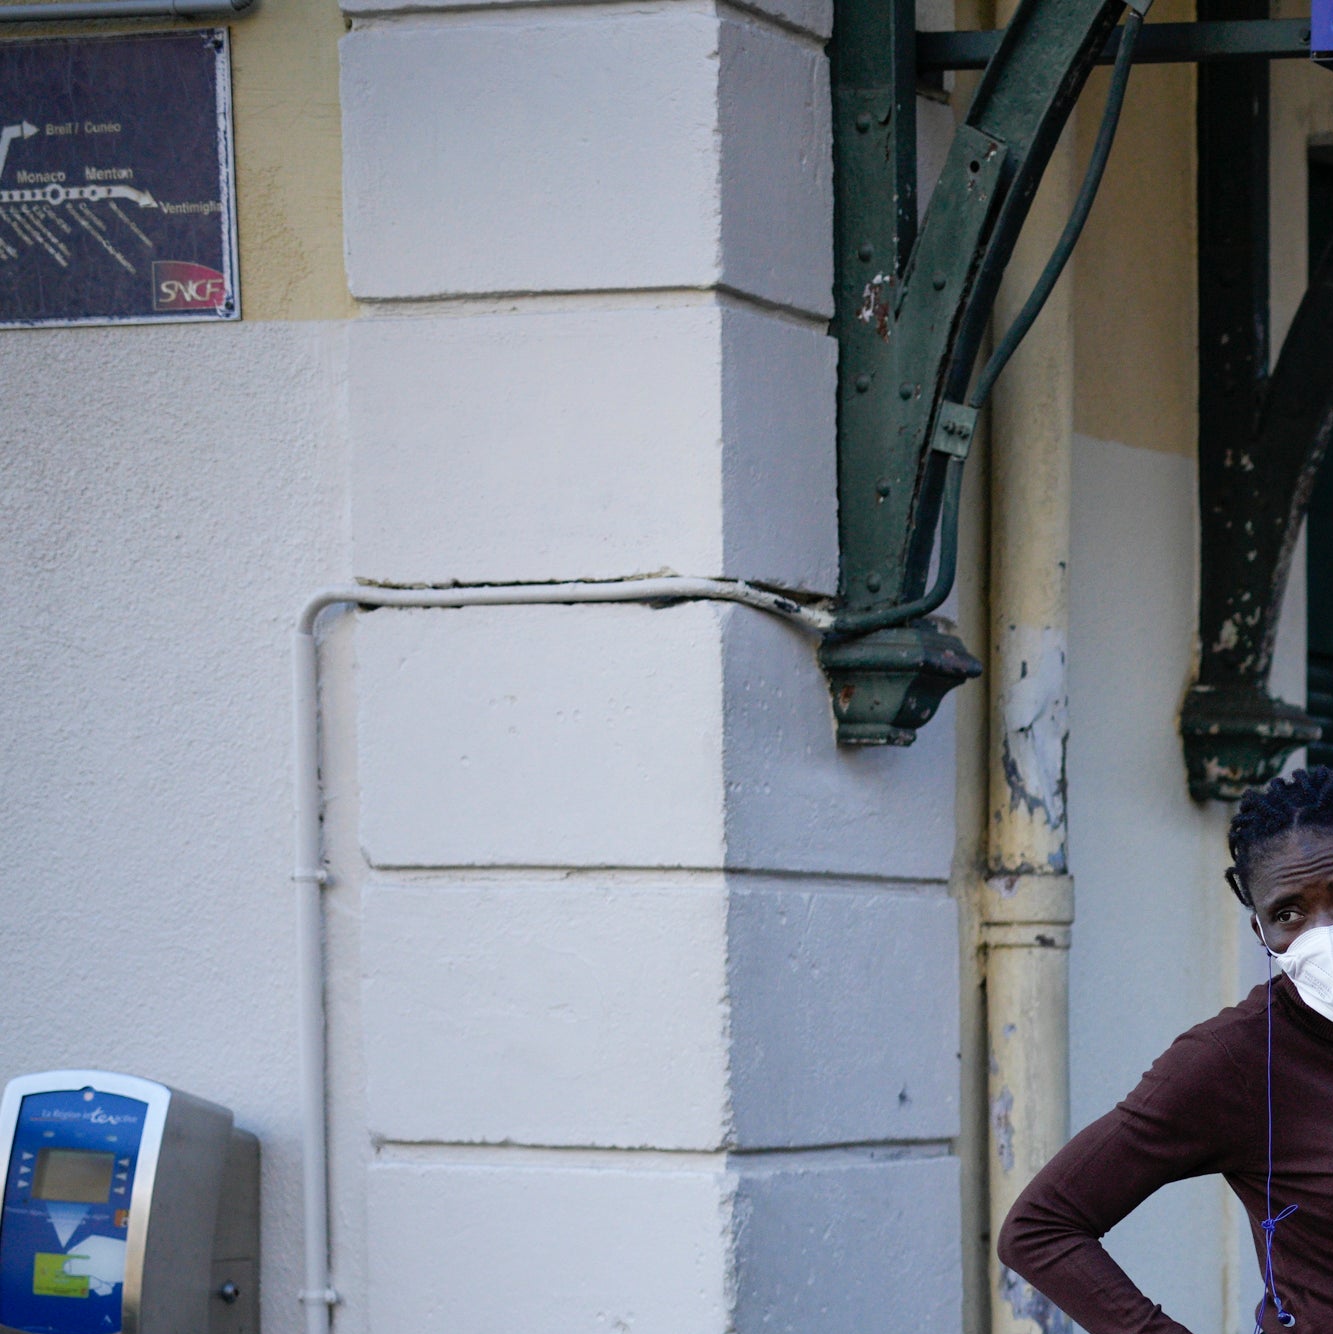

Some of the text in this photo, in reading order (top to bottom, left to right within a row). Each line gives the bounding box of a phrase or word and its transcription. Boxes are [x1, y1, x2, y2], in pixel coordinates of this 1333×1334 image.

[17, 170, 66, 184] Monaco
[85, 166, 134, 180] Menton
[160, 200, 223, 215] Ventimiglia
[159, 279, 223, 303] SNCF
